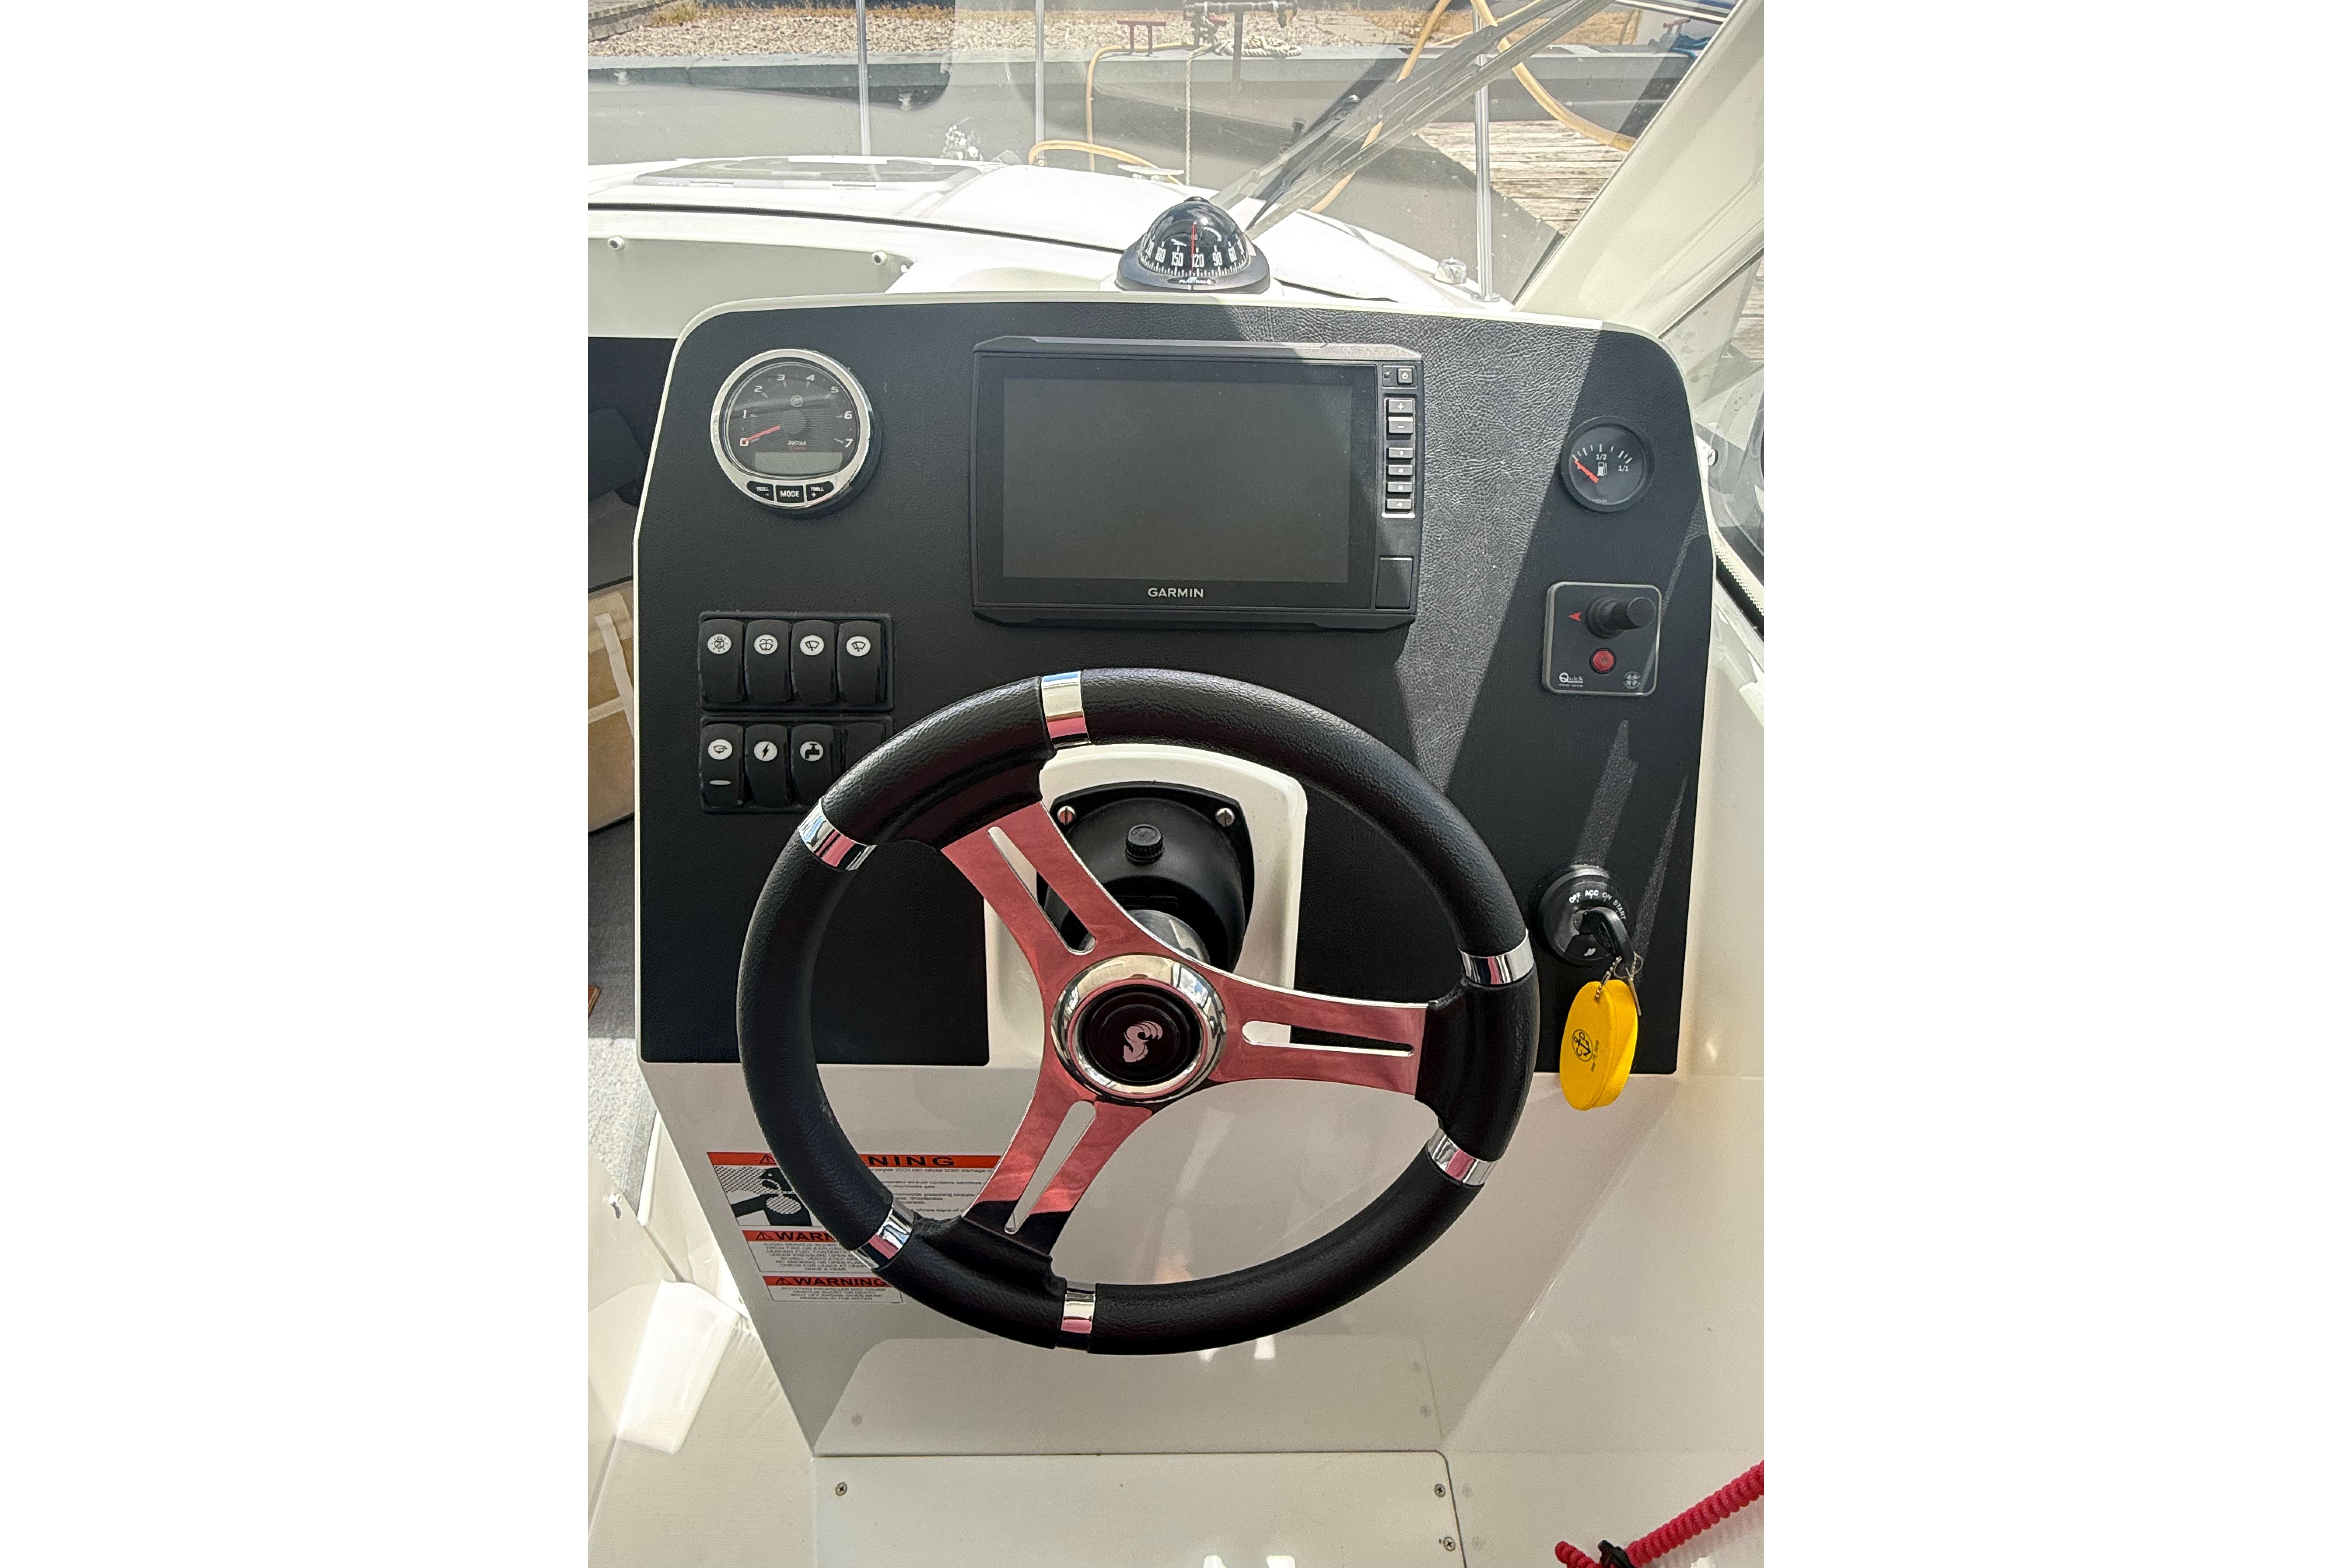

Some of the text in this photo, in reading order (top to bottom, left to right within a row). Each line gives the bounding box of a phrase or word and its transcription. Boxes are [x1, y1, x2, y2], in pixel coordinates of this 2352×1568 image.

[1171, 252, 1184, 267] 150
[1192, 253, 1204, 268] 120
[1212, 251, 1223, 266] 90
[743, 410, 747, 418] 1
[844, 411, 853, 419] 6
[740, 438, 749, 446] 0
[844, 439, 853, 448] 7
[1148, 587, 1204, 598] GARMIN
[1602, 892, 1612, 901] ON
[1613, 900, 1626, 919] START
[868, 1156, 954, 1166] NING
[775, 1232, 835, 1241] WARN
